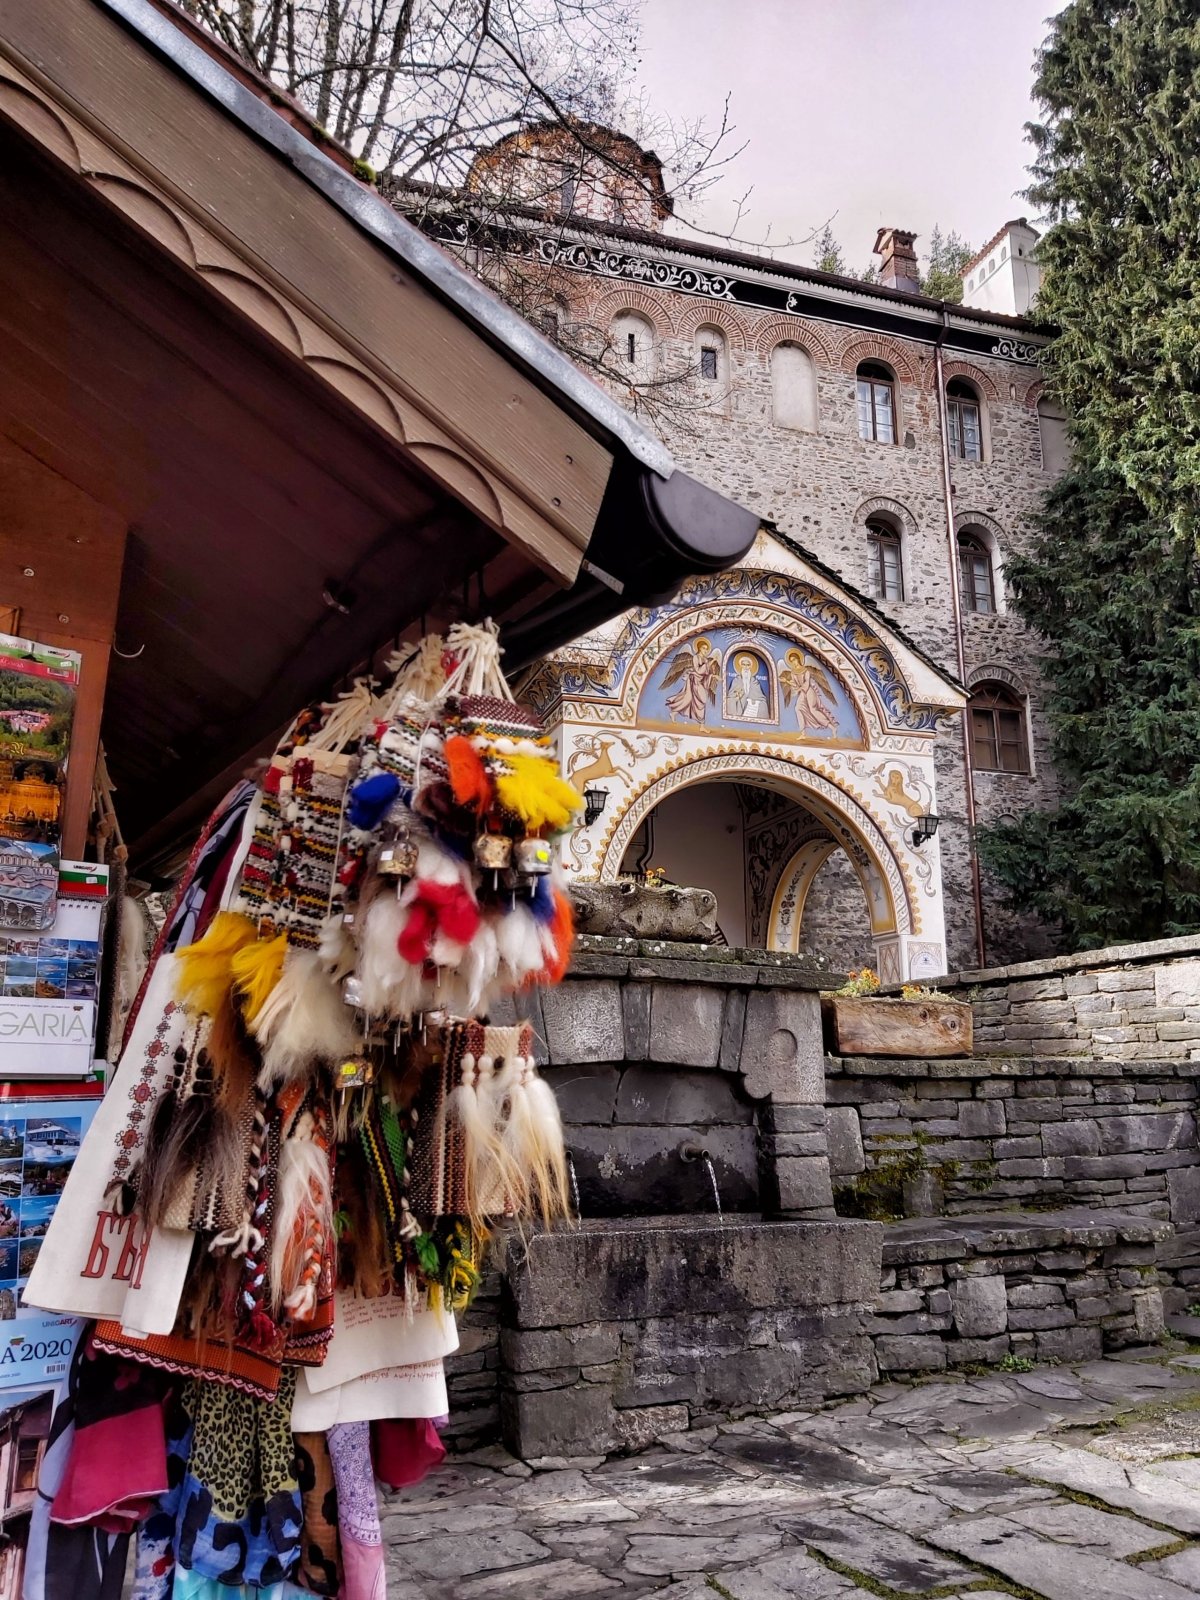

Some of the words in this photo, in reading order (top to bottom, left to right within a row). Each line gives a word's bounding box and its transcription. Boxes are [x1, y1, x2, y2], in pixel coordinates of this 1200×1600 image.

[0, 1012, 88, 1038] GARIA
[0, 1347, 16, 1364] A
[21, 1338, 72, 1362] 2020
